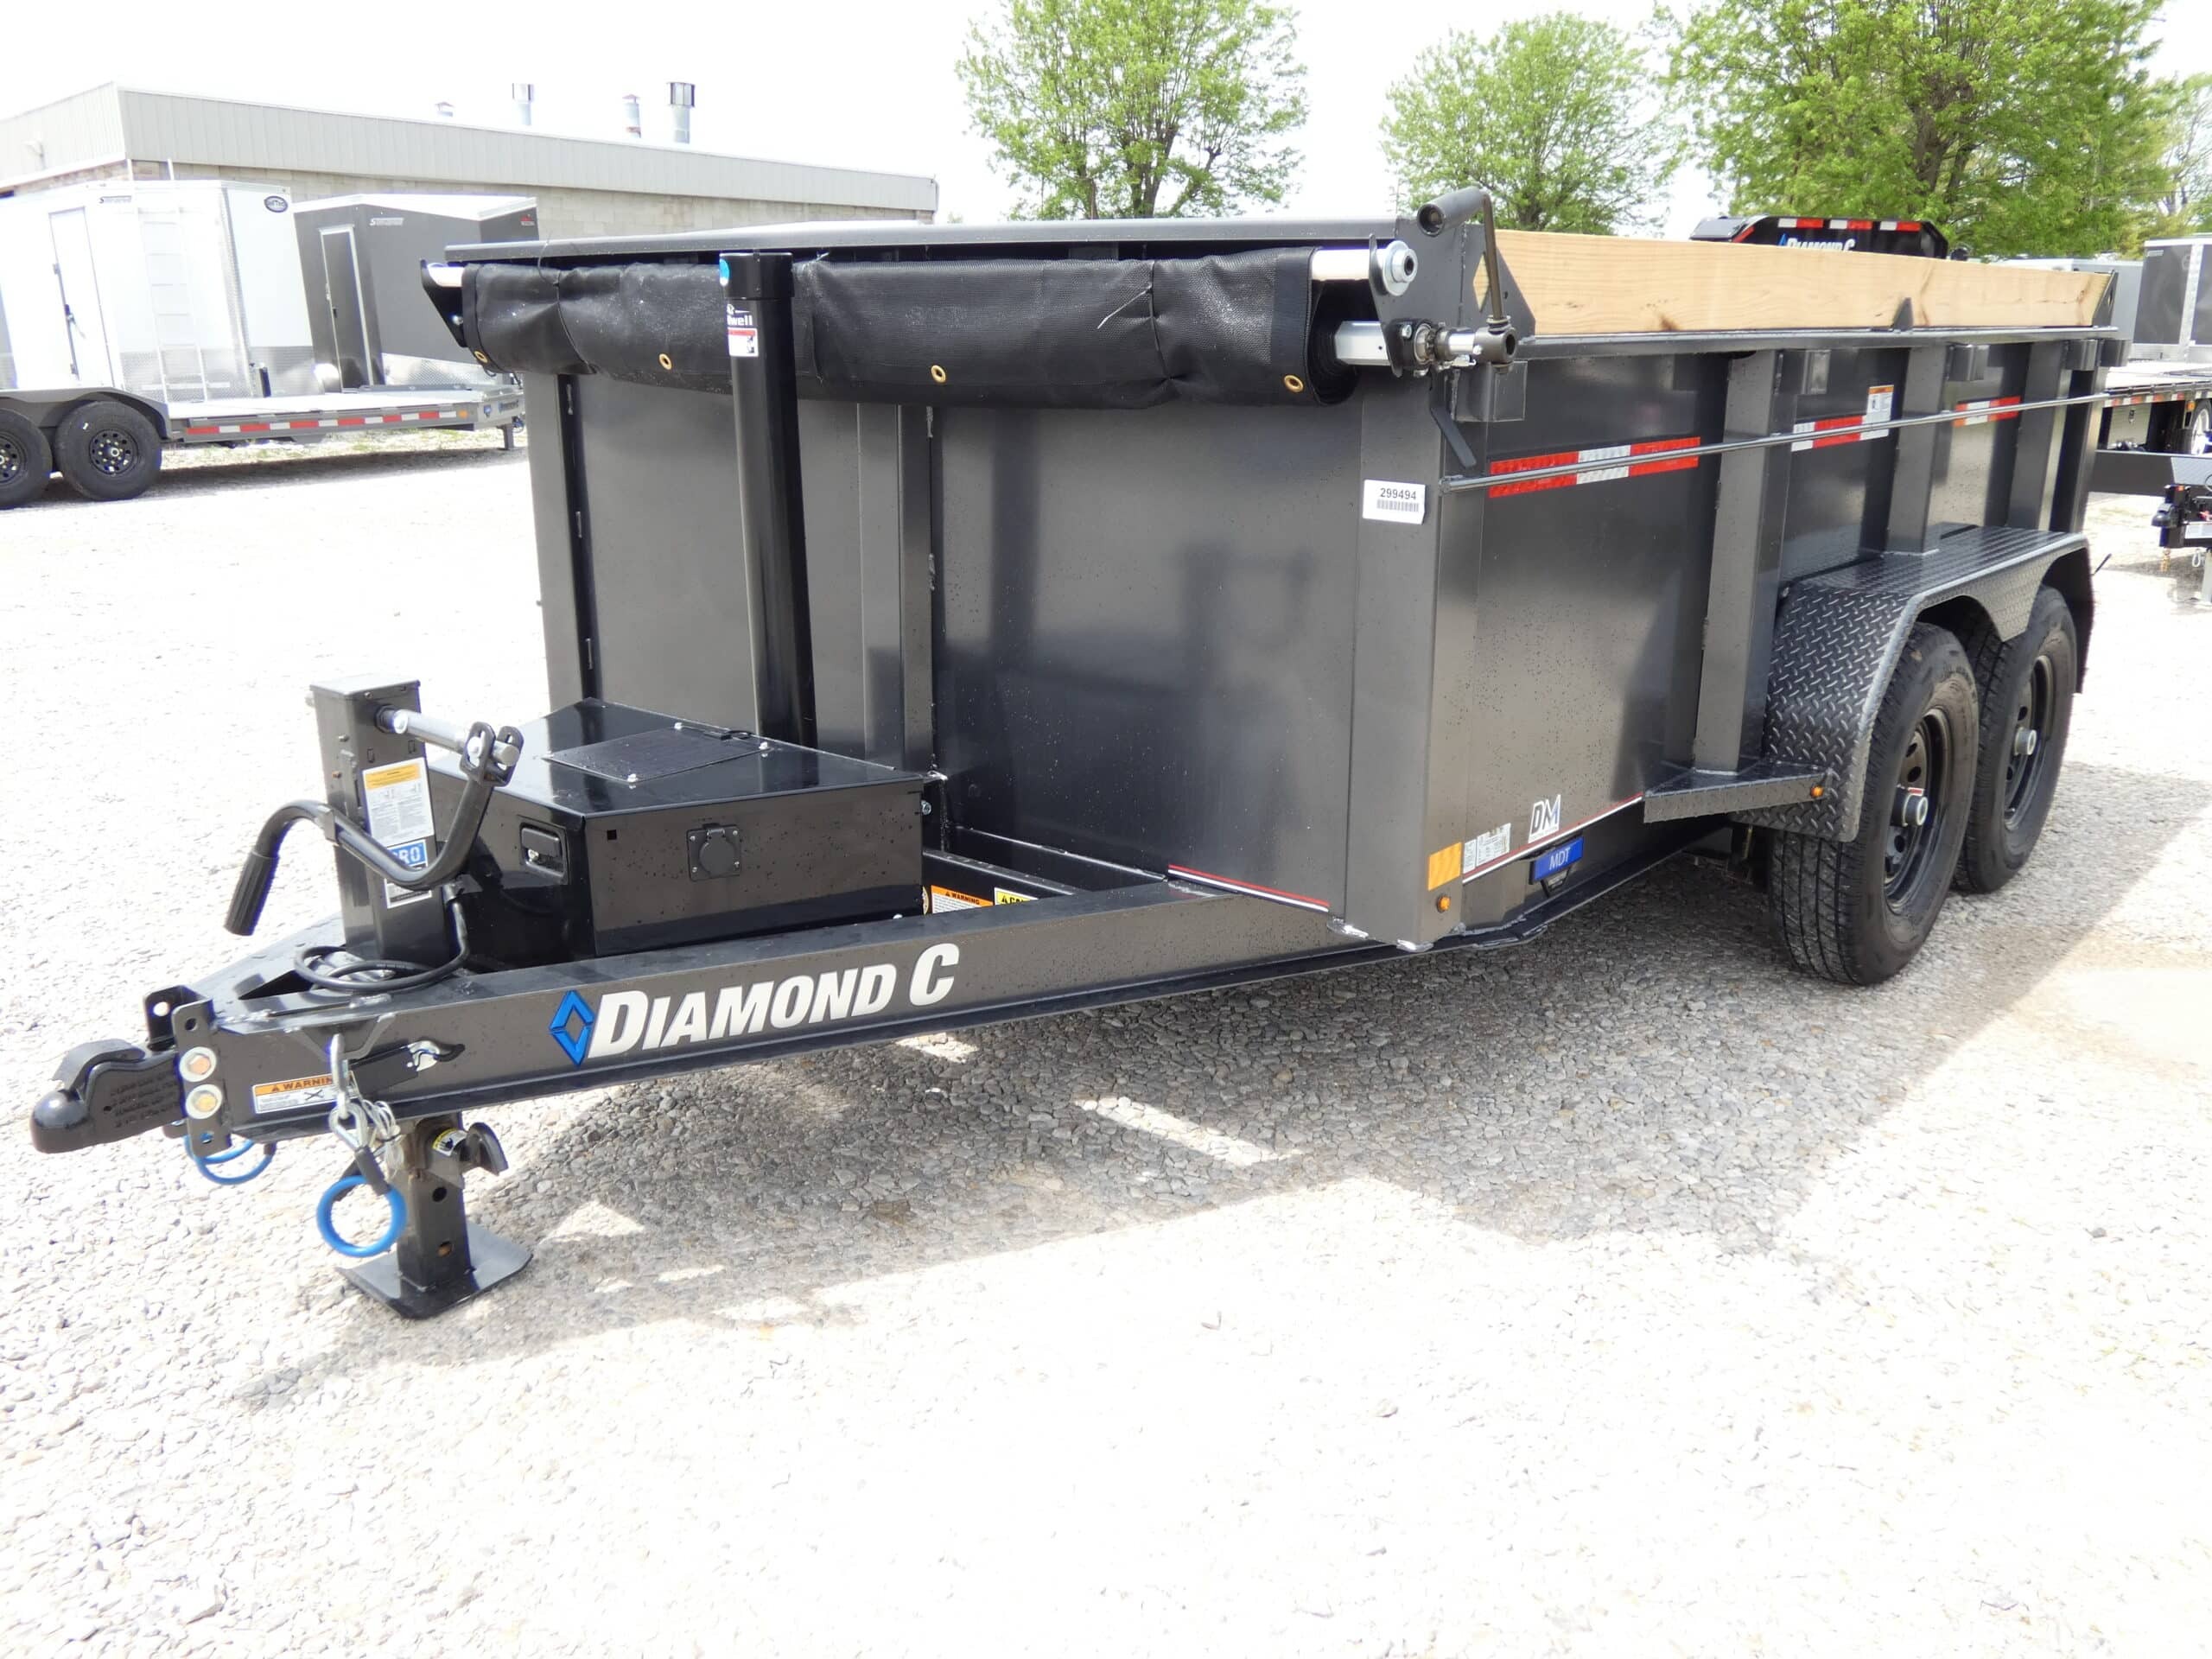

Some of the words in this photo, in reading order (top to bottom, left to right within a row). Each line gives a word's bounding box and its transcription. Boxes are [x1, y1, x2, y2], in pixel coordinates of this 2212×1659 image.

[1380, 487, 1417, 500] 299494
[391, 846, 421, 864] RO
[1548, 847, 1572, 871] MDT
[951, 893, 980, 905] WARNING
[588, 963, 897, 1058] DIAMOND
[909, 943, 960, 1007] C
[283, 1077, 333, 1090] WARNIN
